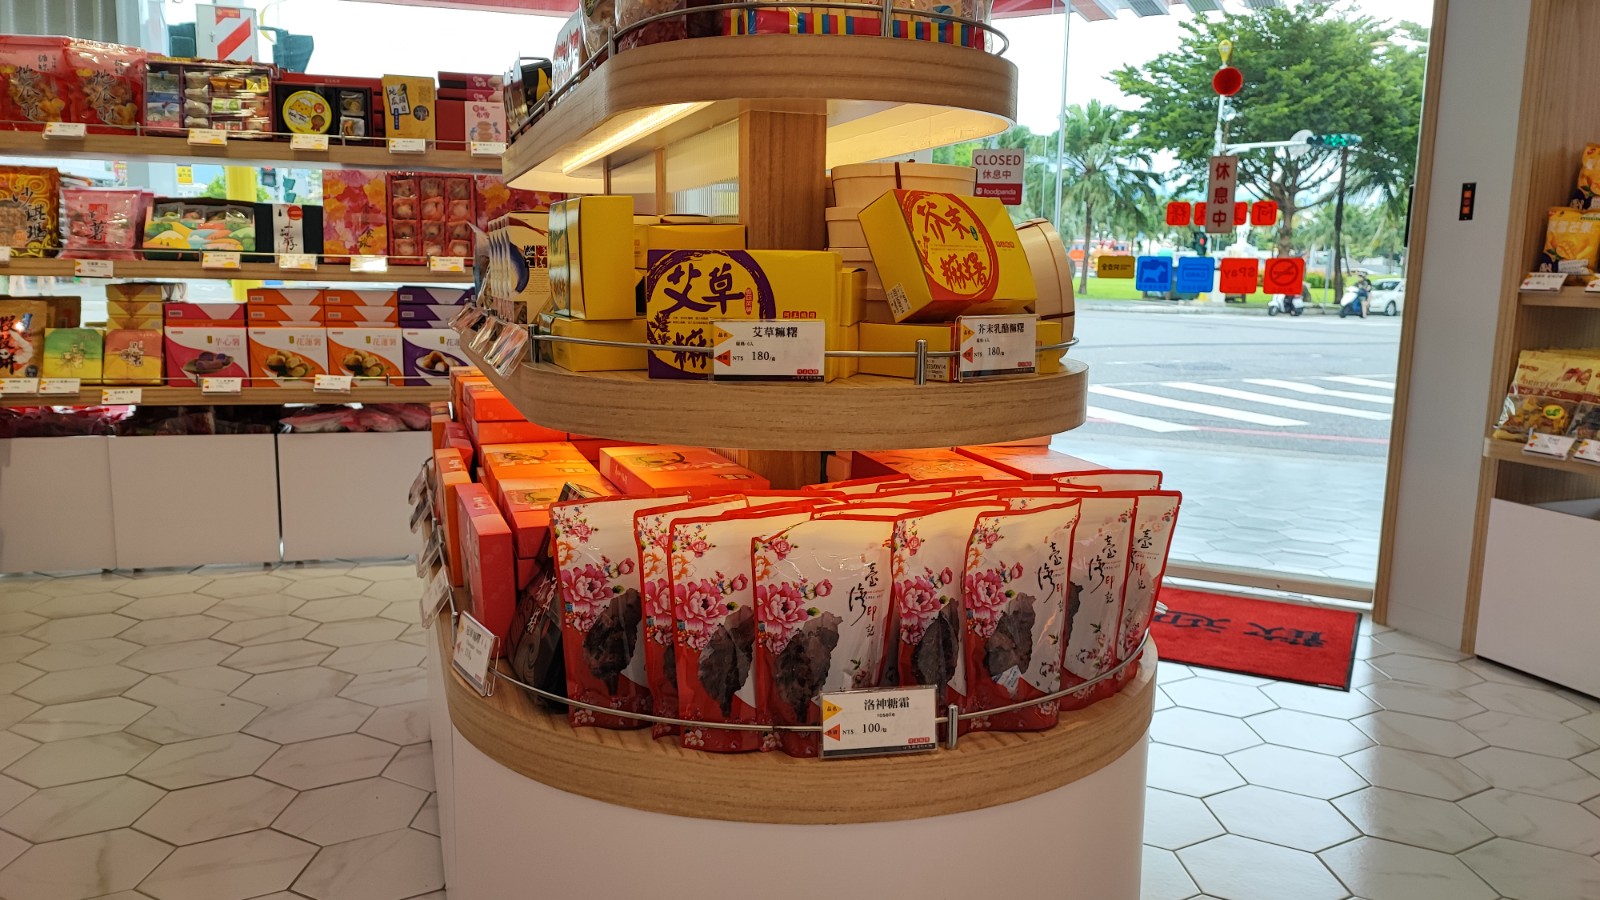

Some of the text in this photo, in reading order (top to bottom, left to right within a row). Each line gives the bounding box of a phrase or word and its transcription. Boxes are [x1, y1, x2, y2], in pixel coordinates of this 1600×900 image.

[975, 154, 1021, 166] CLOSED
[982, 169, 1012, 180] 休息中
[983, 187, 1017, 196] foodpanda
[1212, 162, 1231, 228] 休息中
[916, 200, 972, 244] 芥末
[663, 262, 745, 315] 艾草
[1088, 535, 1117, 604] 臺灣印記
[848, 562, 880, 638] 臺灣印記
[863, 696, 910, 711] 洛神糖霜
